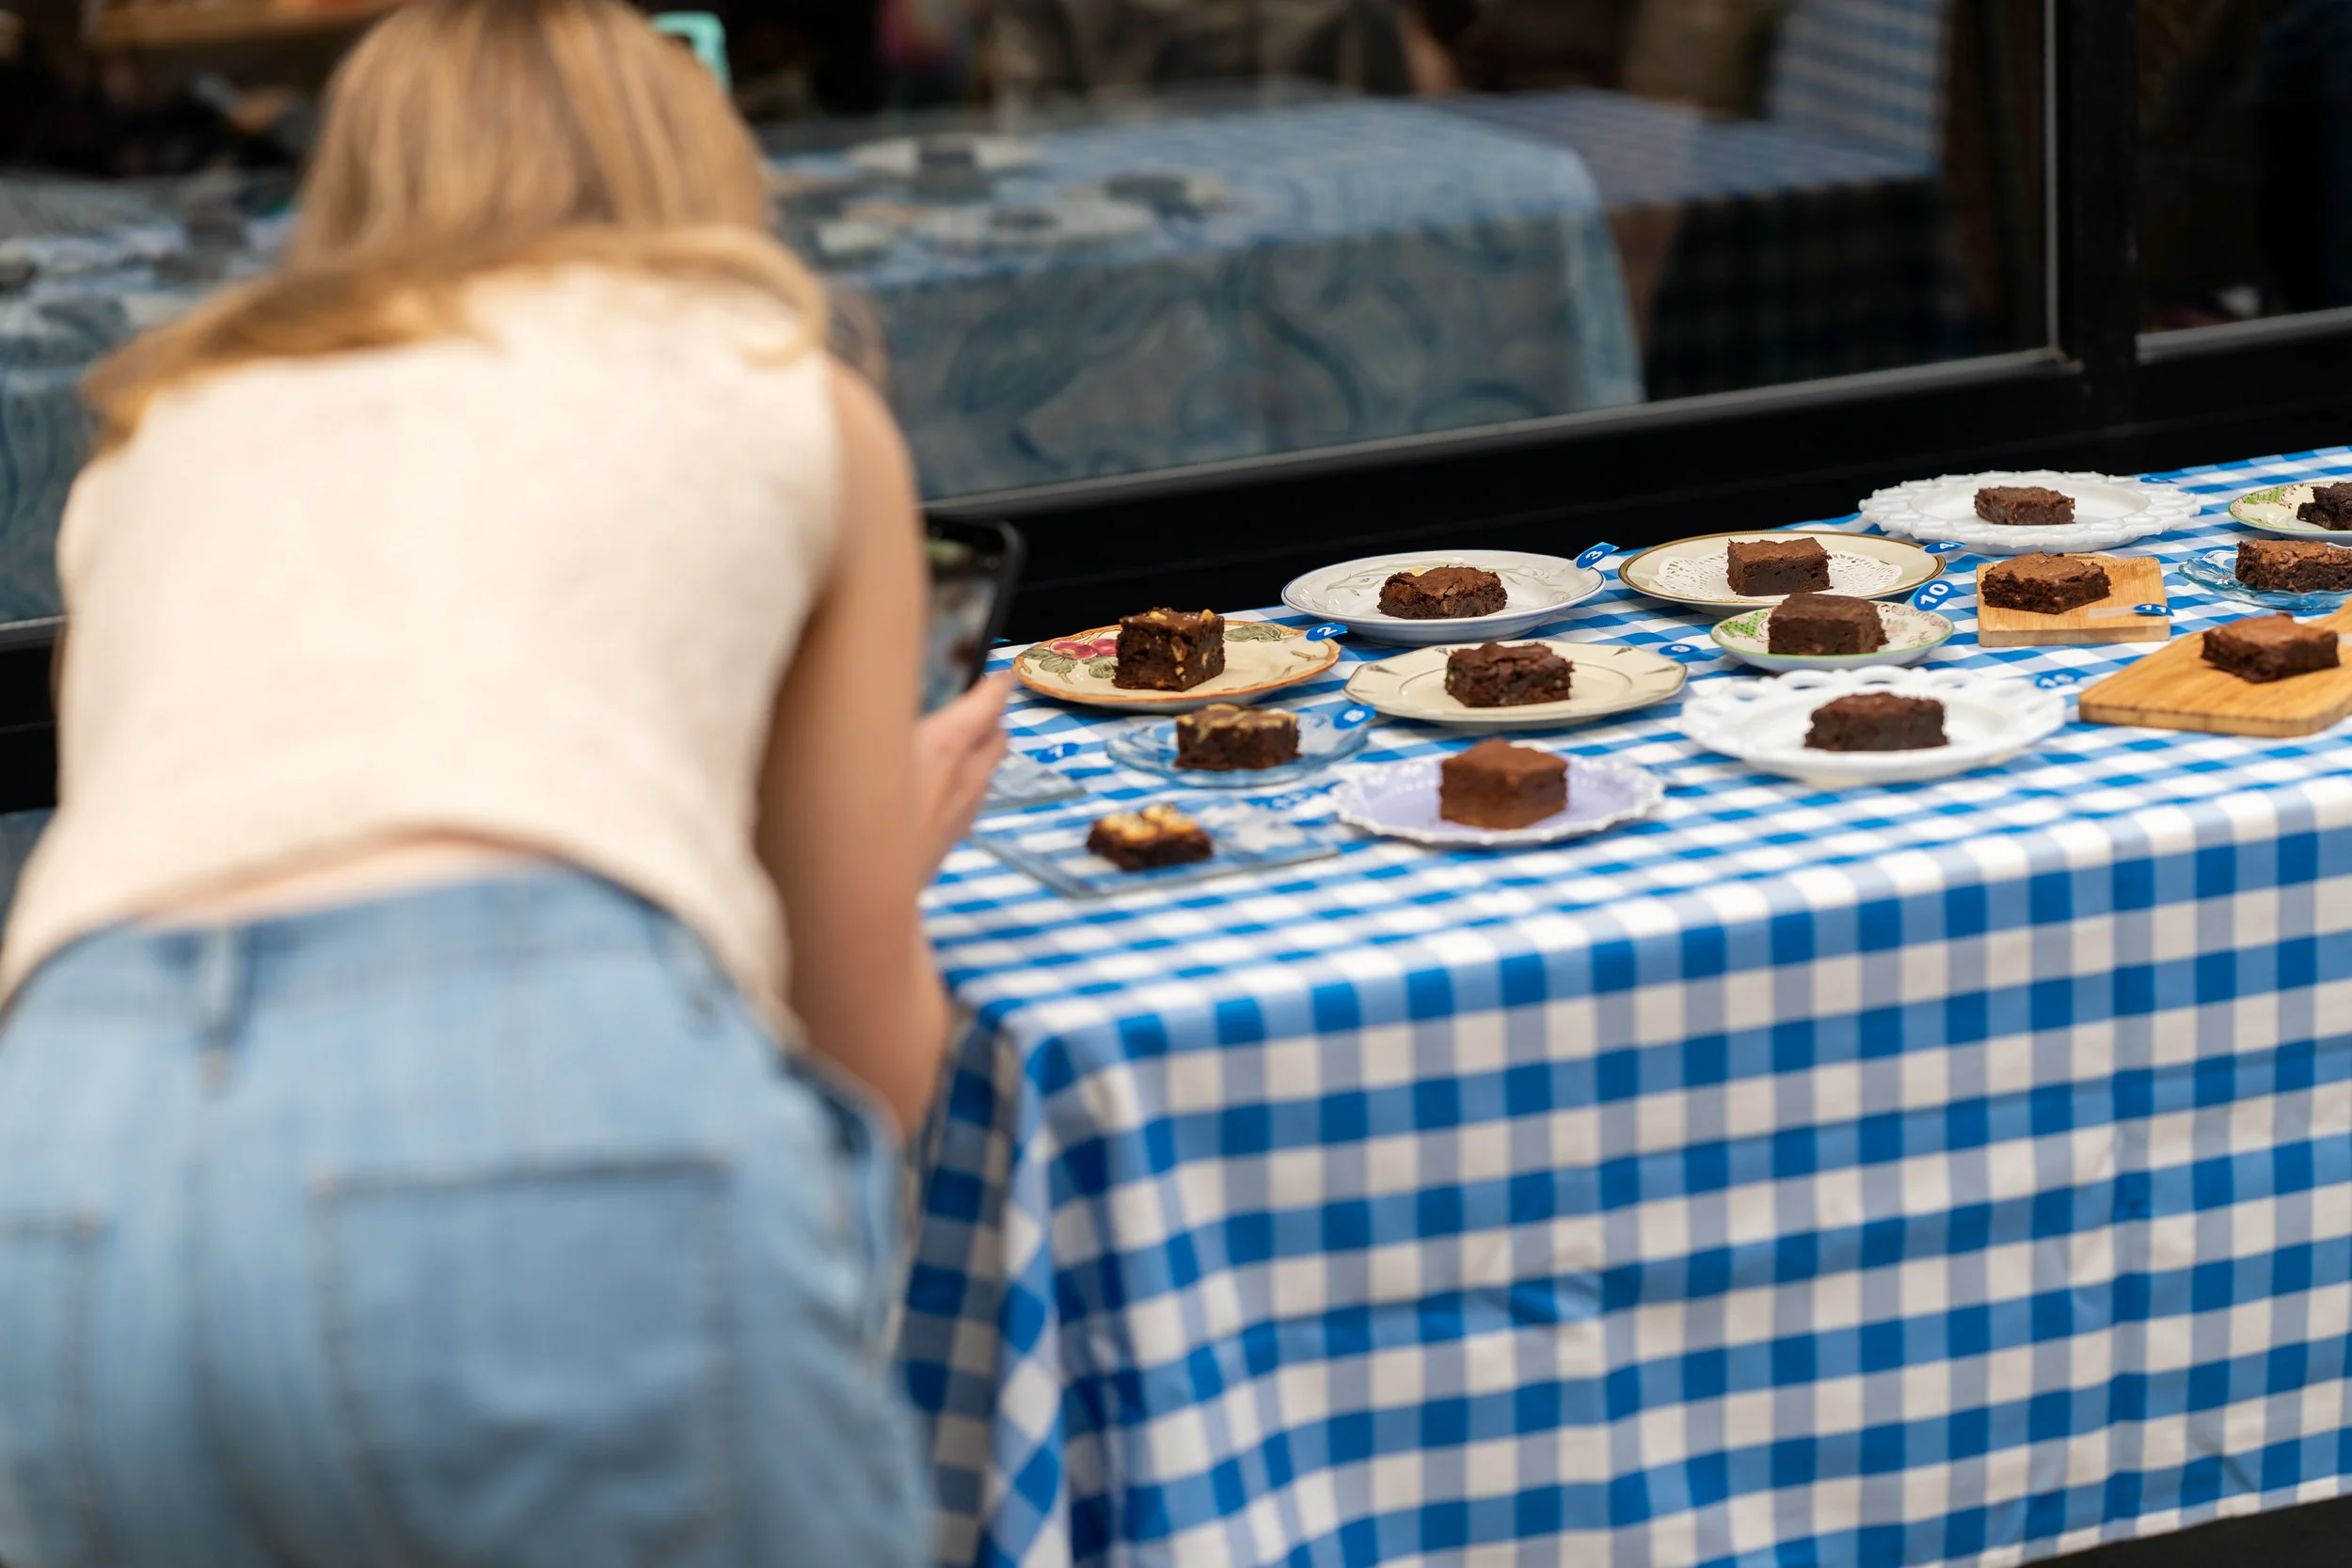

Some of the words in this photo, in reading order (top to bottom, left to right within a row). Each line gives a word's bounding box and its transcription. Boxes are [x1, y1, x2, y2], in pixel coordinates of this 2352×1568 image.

[1585, 550, 1603, 561] 3
[1920, 583, 1949, 605] 10
[1316, 626, 1337, 637] 2
